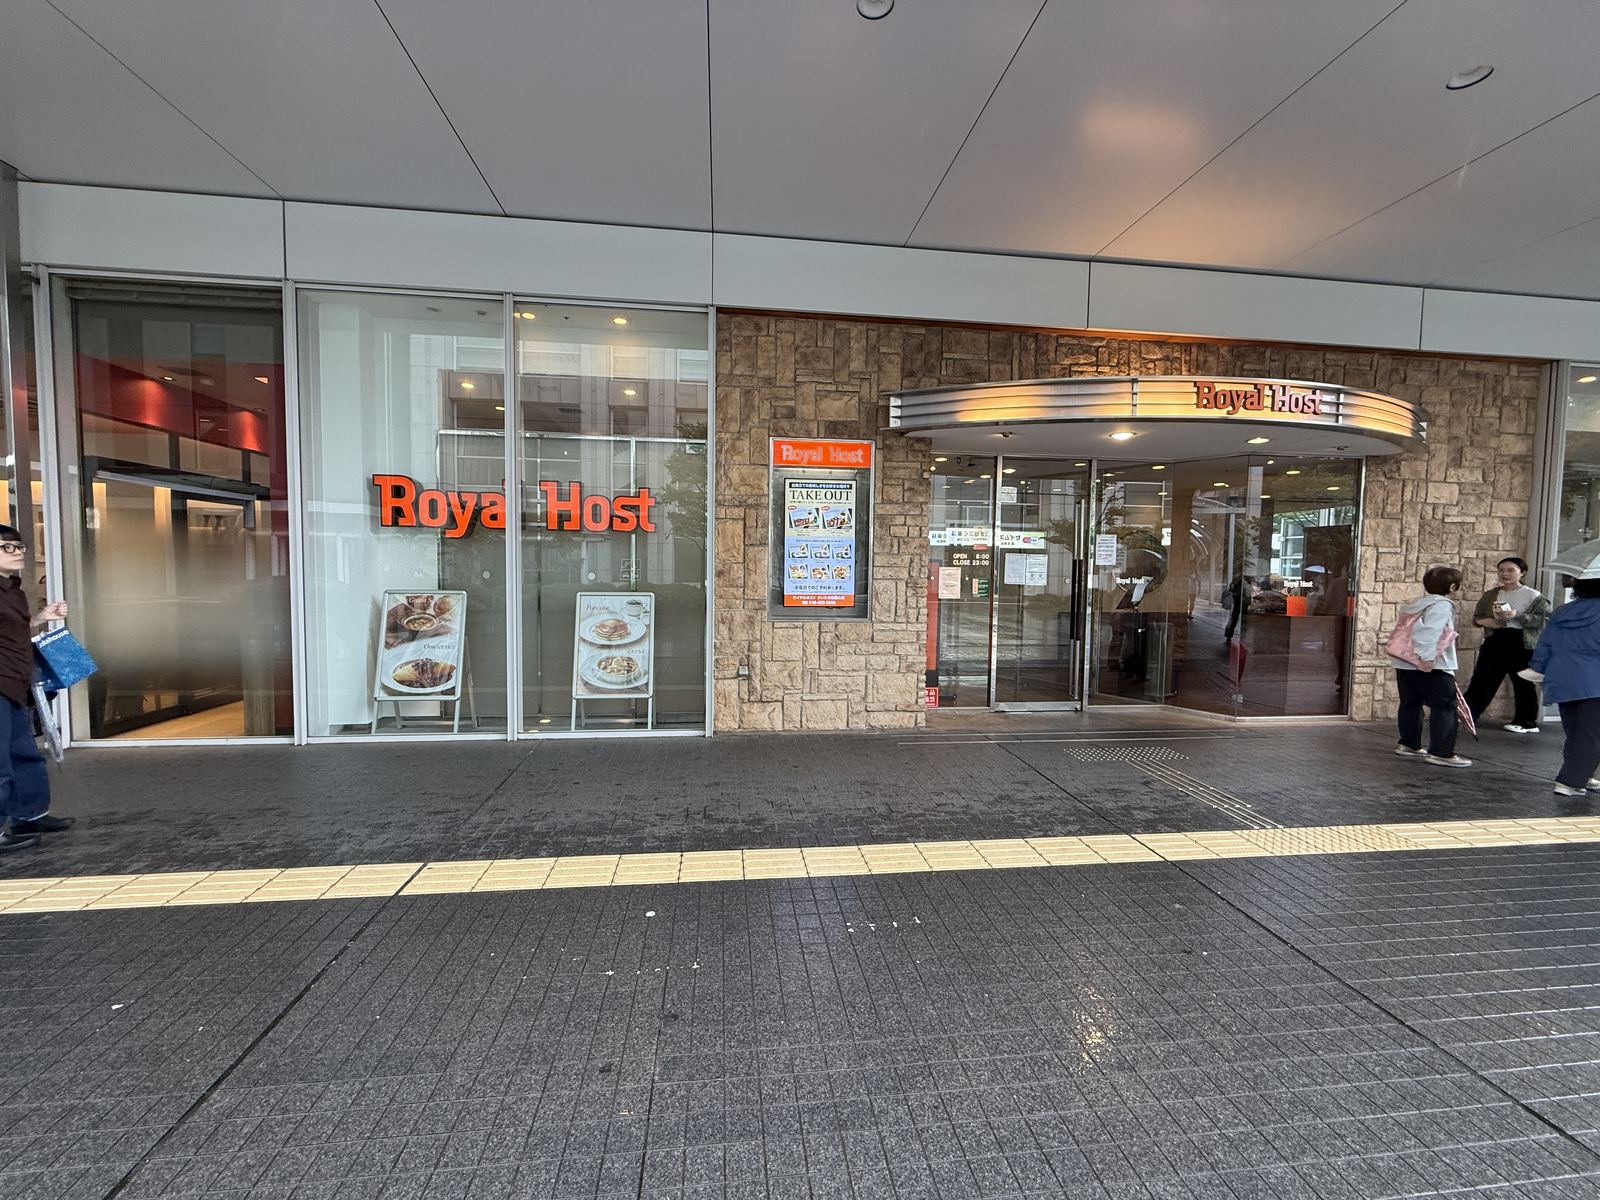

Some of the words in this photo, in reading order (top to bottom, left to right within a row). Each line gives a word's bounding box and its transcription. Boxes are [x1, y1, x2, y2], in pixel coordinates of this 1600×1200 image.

[1194, 381, 1265, 415] Royal
[1271, 384, 1322, 415] Host
[781, 444, 823, 465] Royal
[372, 474, 507, 539] Roya
[539, 480, 656, 533] Host
[789, 490, 821, 501] TAKE
[824, 490, 852, 501] OUT
